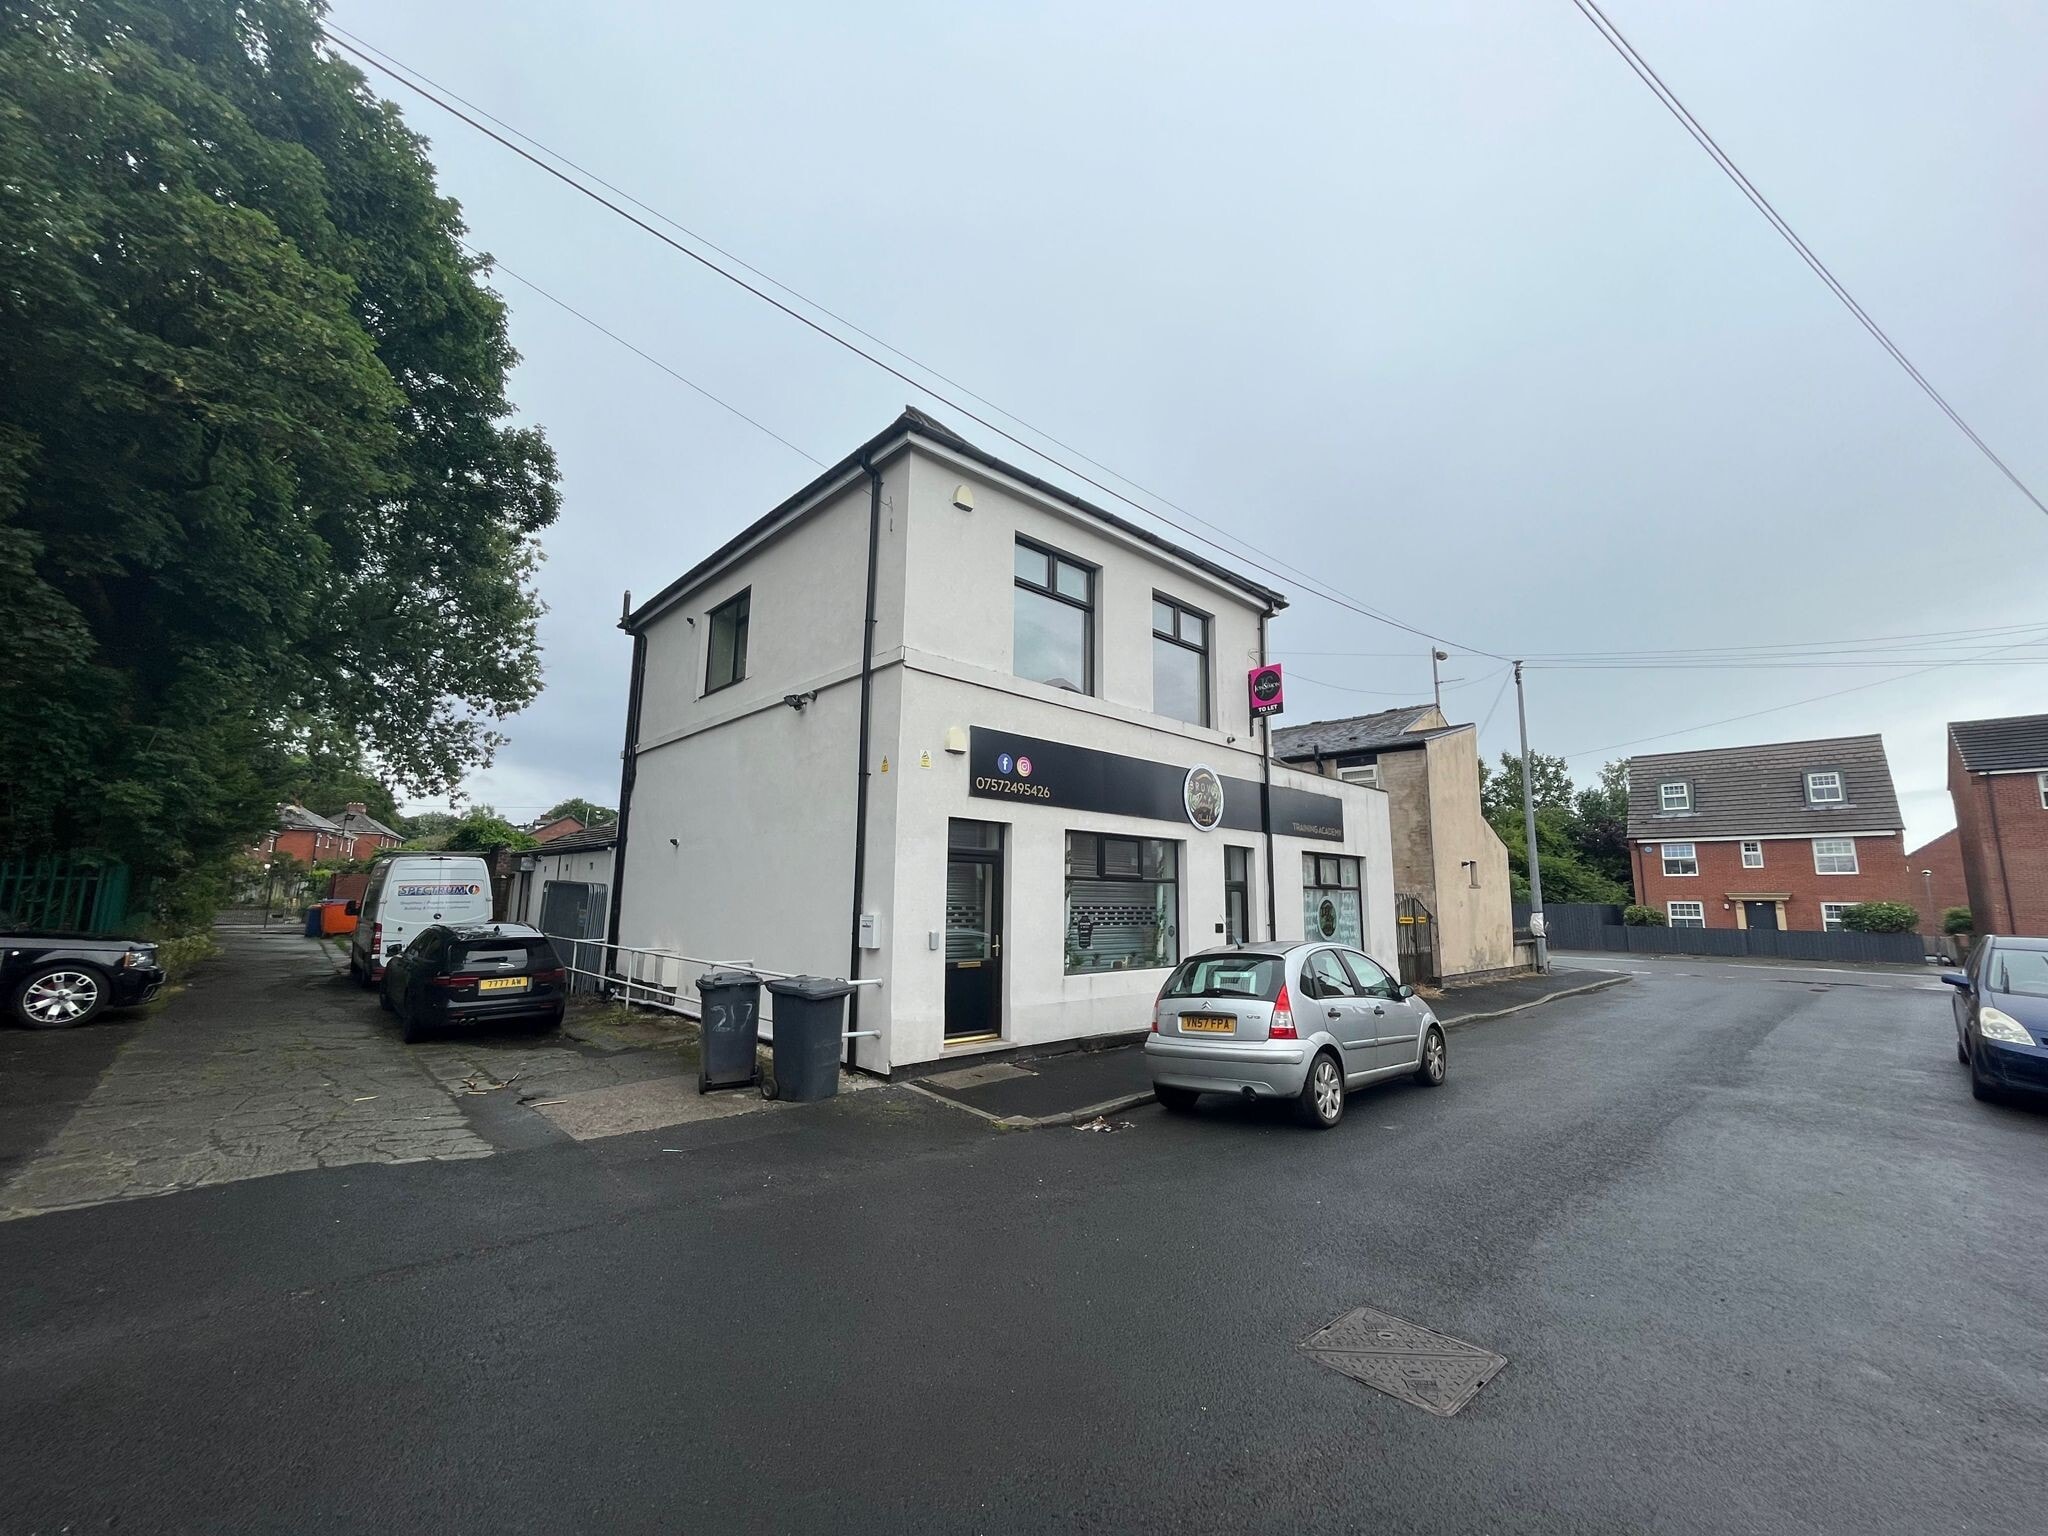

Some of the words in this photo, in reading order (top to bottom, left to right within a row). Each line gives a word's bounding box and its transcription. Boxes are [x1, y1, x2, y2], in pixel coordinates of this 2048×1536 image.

[976, 776, 1050, 799] 07572495426
[400, 885, 466, 895] SPECTRUM
[487, 980, 509, 988] 7777
[710, 1003, 753, 1032] 217
[1210, 1018, 1230, 1029] FPA
